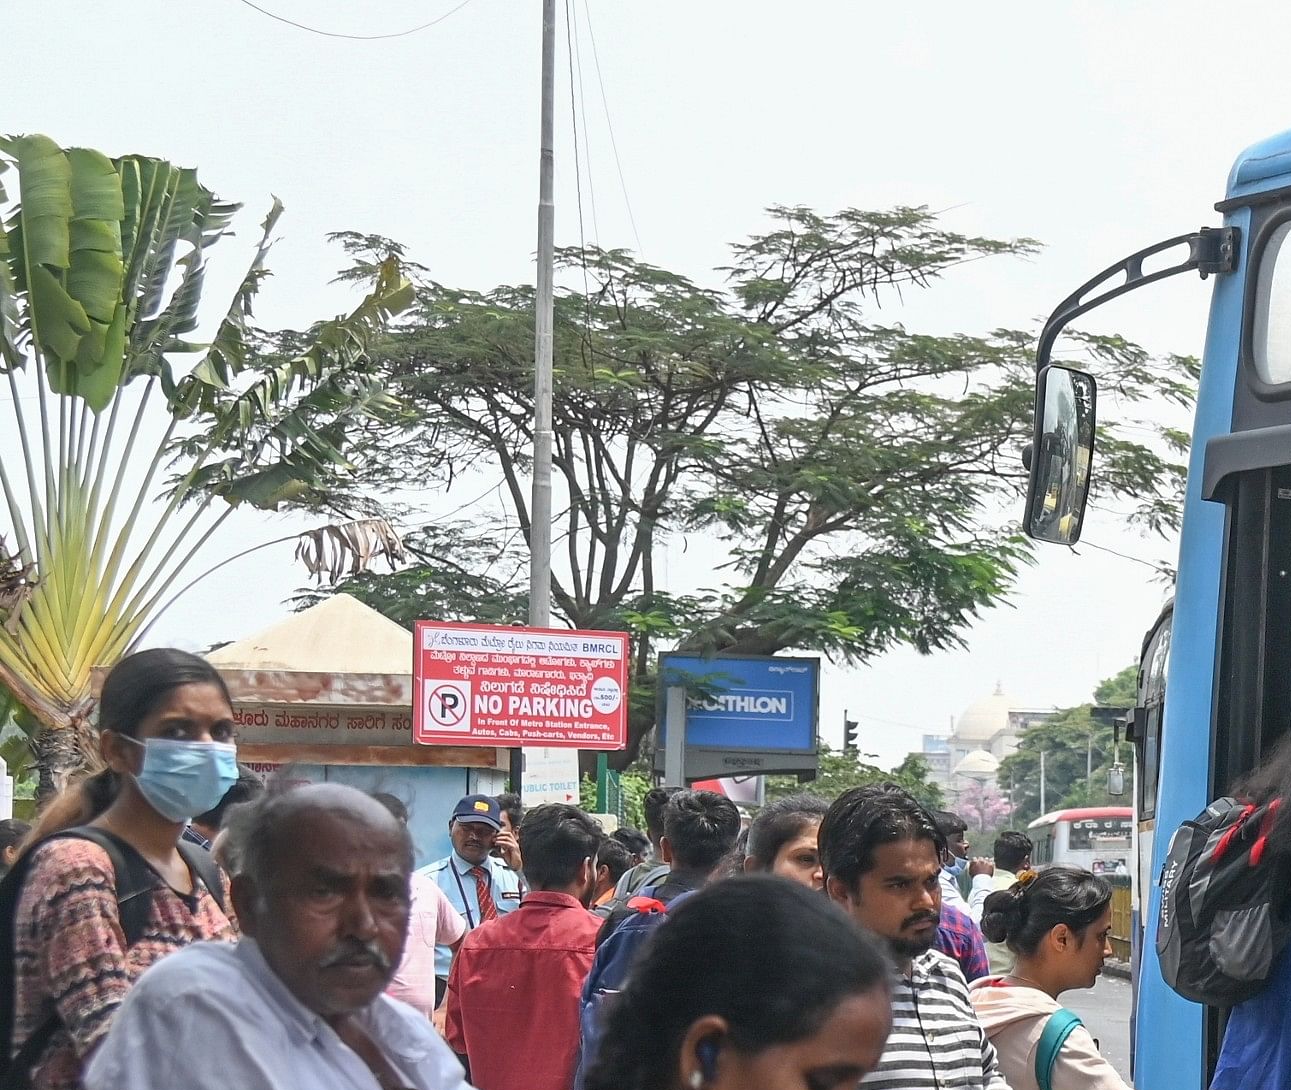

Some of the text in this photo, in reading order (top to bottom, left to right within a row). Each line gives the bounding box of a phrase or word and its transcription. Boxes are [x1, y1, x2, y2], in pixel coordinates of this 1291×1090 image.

[582, 643, 618, 654] BMRCL
[480, 679, 525, 694] ನಿಲುಗಡೆ
[474, 694, 593, 719] NO PARKING
[275, 711, 340, 728] ಮಹಾನಗರ
[346, 712, 386, 731] ಸಾರಿಗೆ
[391, 714, 412, 731] ಸಂ
[487, 718, 508, 727] Front
[509, 719, 520, 727] Of
[521, 720, 544, 728] Metro
[545, 721, 573, 729] Station
[574, 722, 610, 731] Entrance,
[471, 727, 615, 740] Autos, Cabs, Push-carts, Vendors, Etc
[549, 781, 577, 791] TOILET
[1163, 859, 1179, 928] MILITARY
